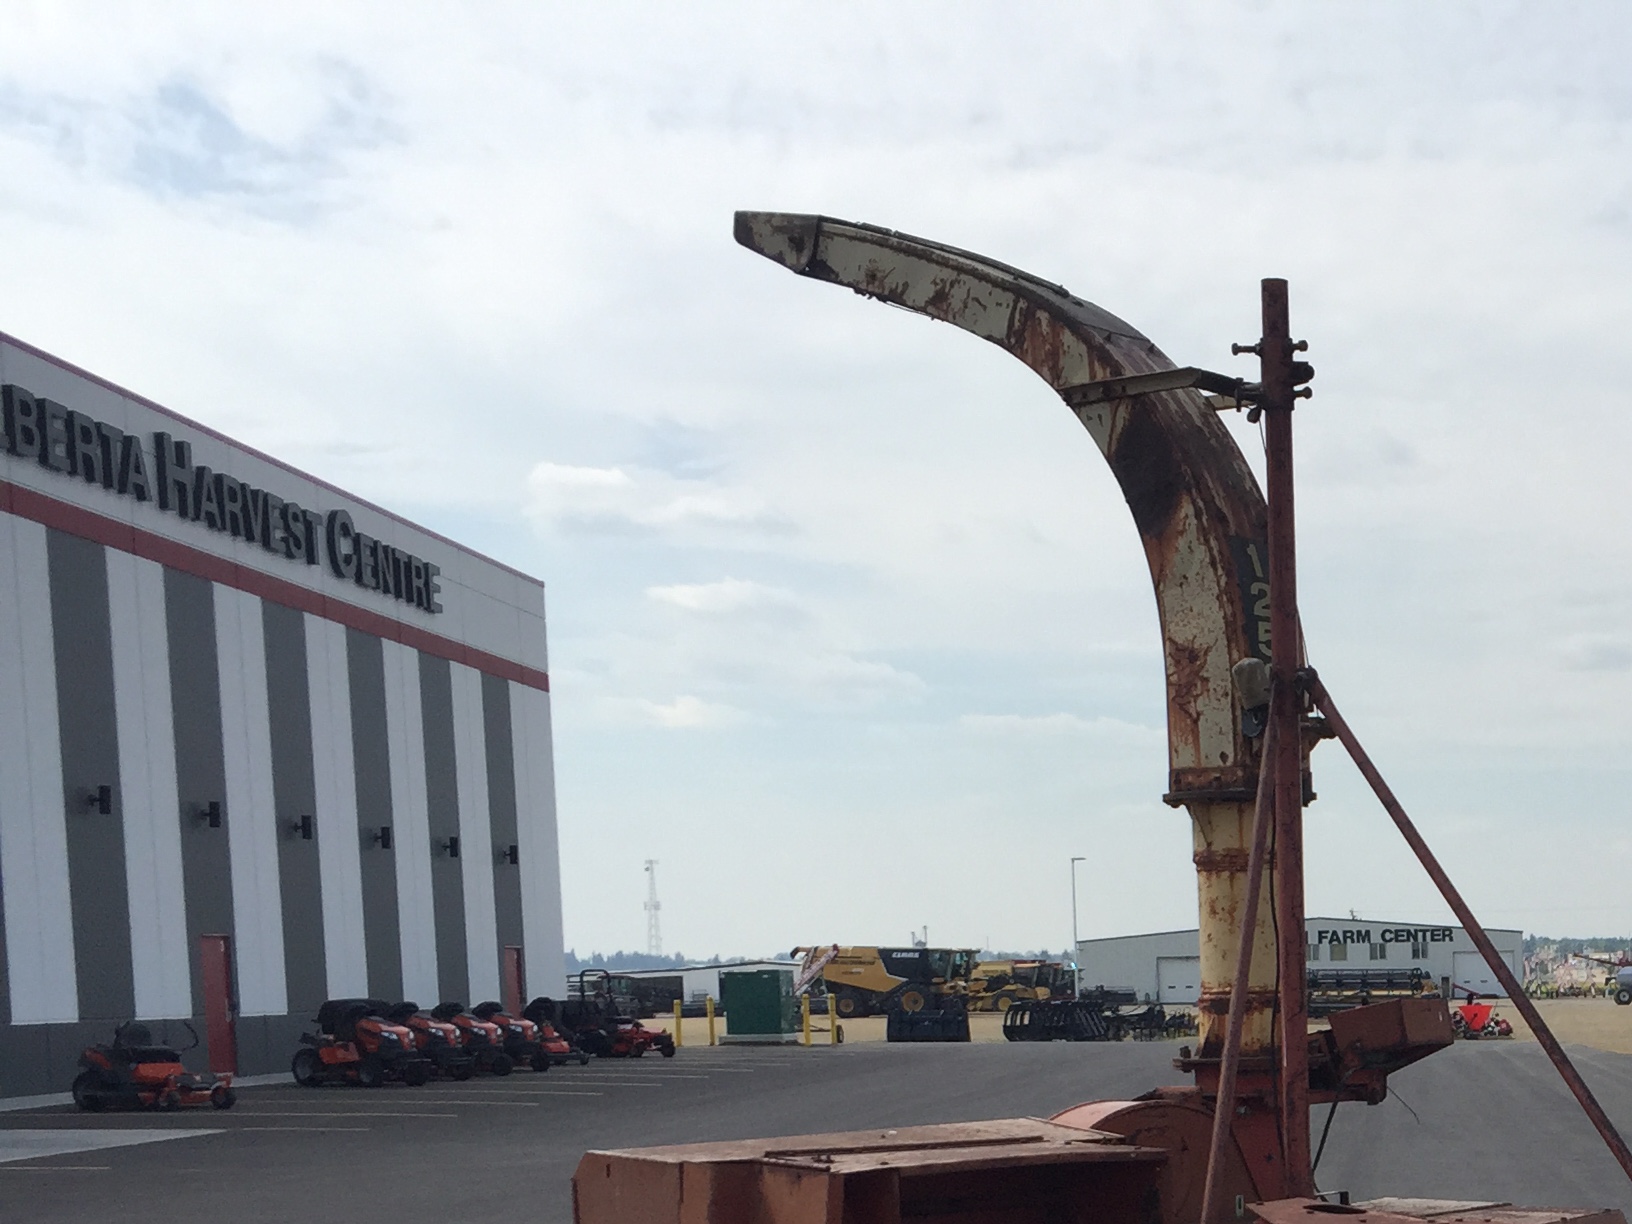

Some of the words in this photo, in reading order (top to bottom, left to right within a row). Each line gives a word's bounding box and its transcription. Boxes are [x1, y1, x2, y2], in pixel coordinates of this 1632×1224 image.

[0, 383, 152, 502] BERTA
[154, 431, 324, 566] HARVEST
[326, 508, 444, 614] CENTRE
[1317, 929, 1371, 945] FARM
[1380, 928, 1454, 943] CENTER
